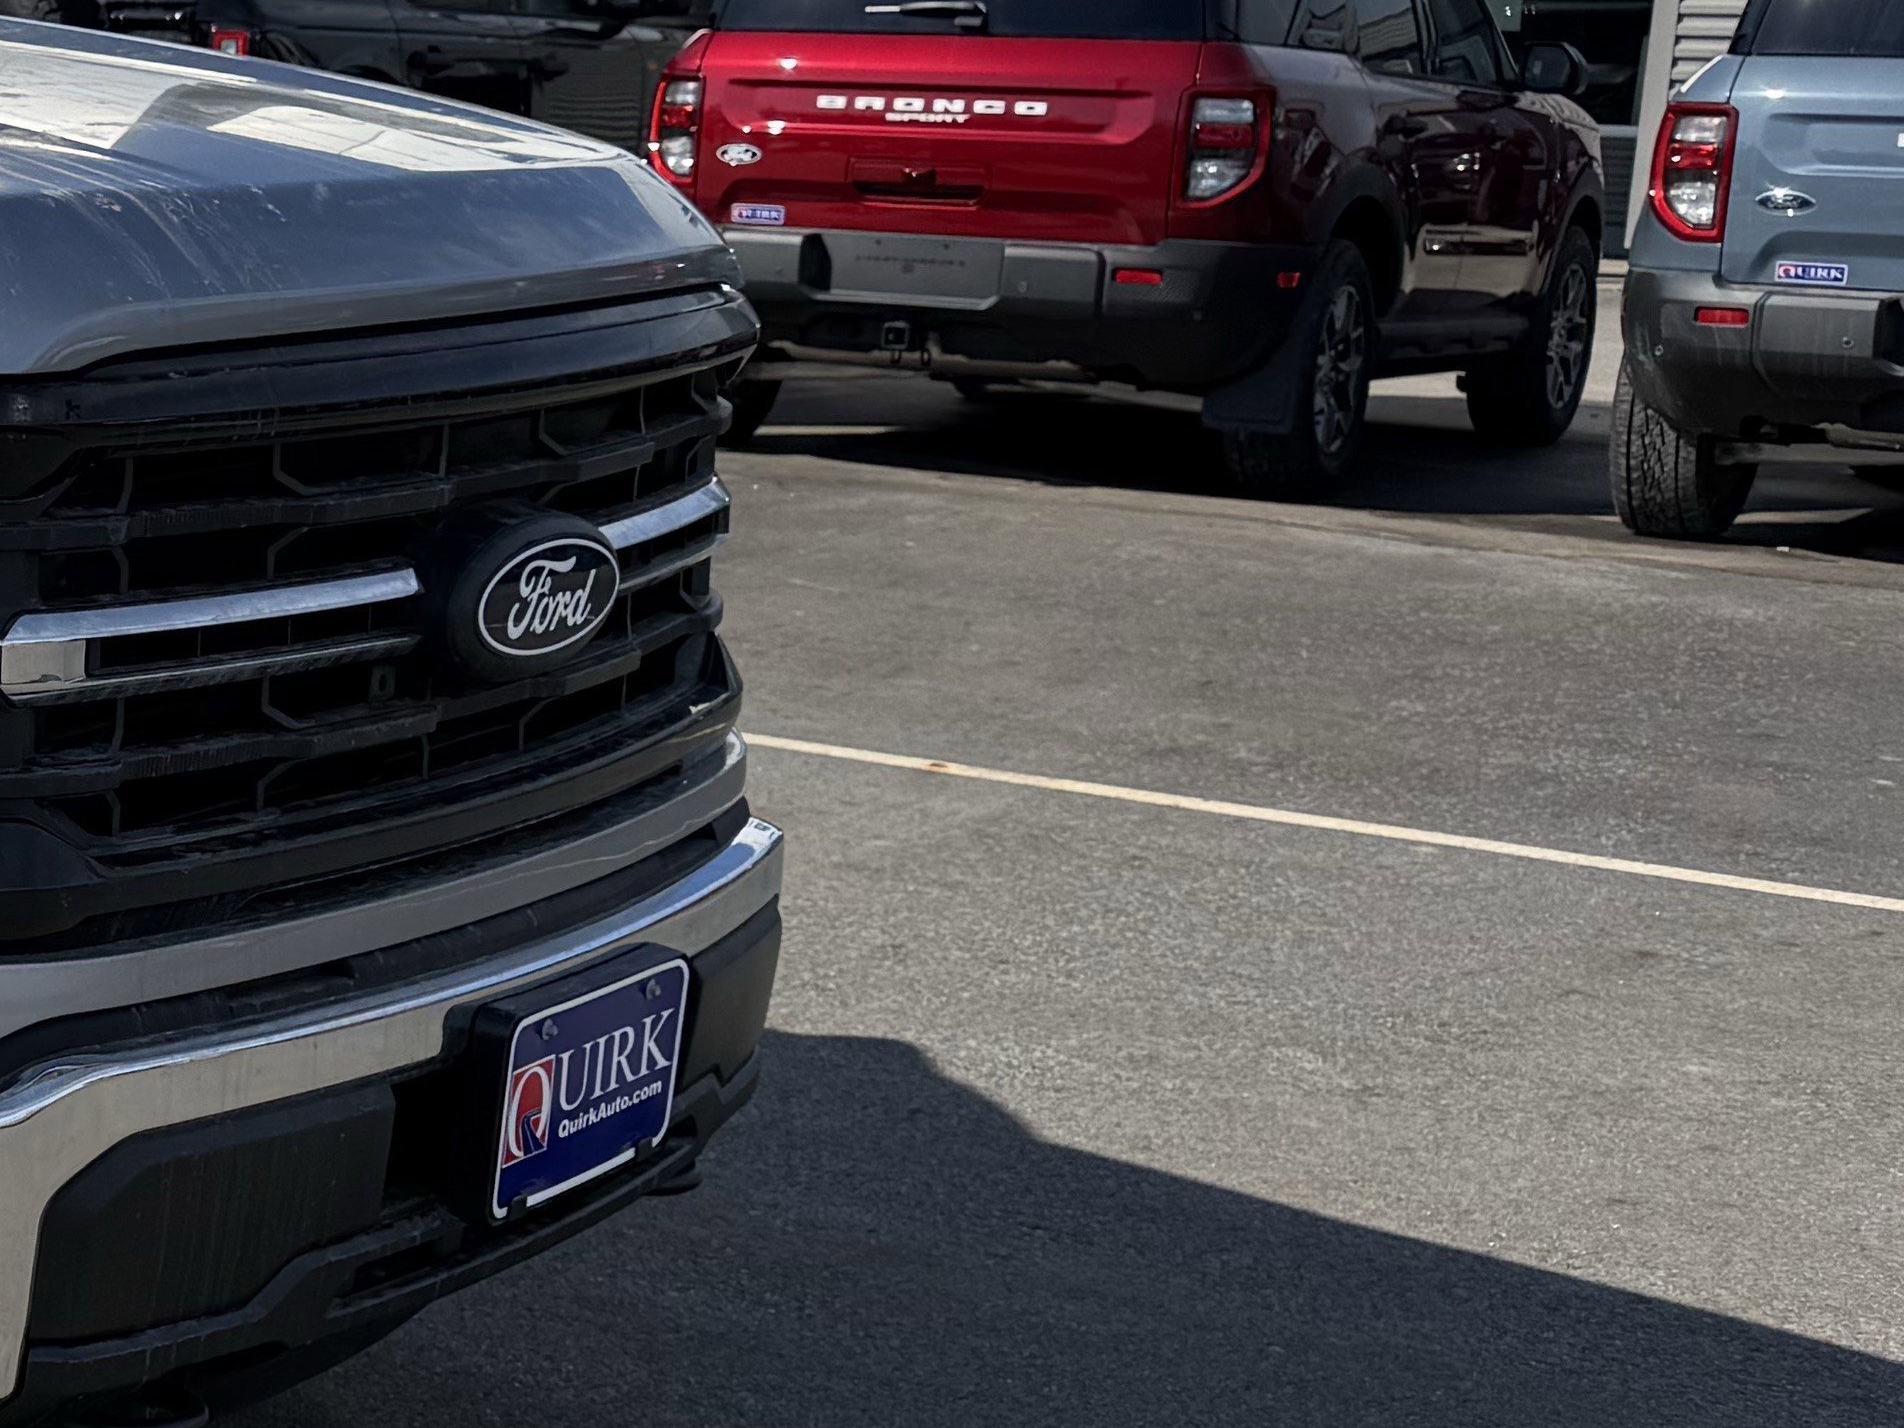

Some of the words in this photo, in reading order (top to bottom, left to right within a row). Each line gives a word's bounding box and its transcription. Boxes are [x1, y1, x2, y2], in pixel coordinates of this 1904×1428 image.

[816, 95, 1048, 116] BRONCO
[507, 556, 596, 640] Ford
[508, 1008, 675, 1158] QUIRK
[558, 1080, 662, 1138] QuirkAuto.com
